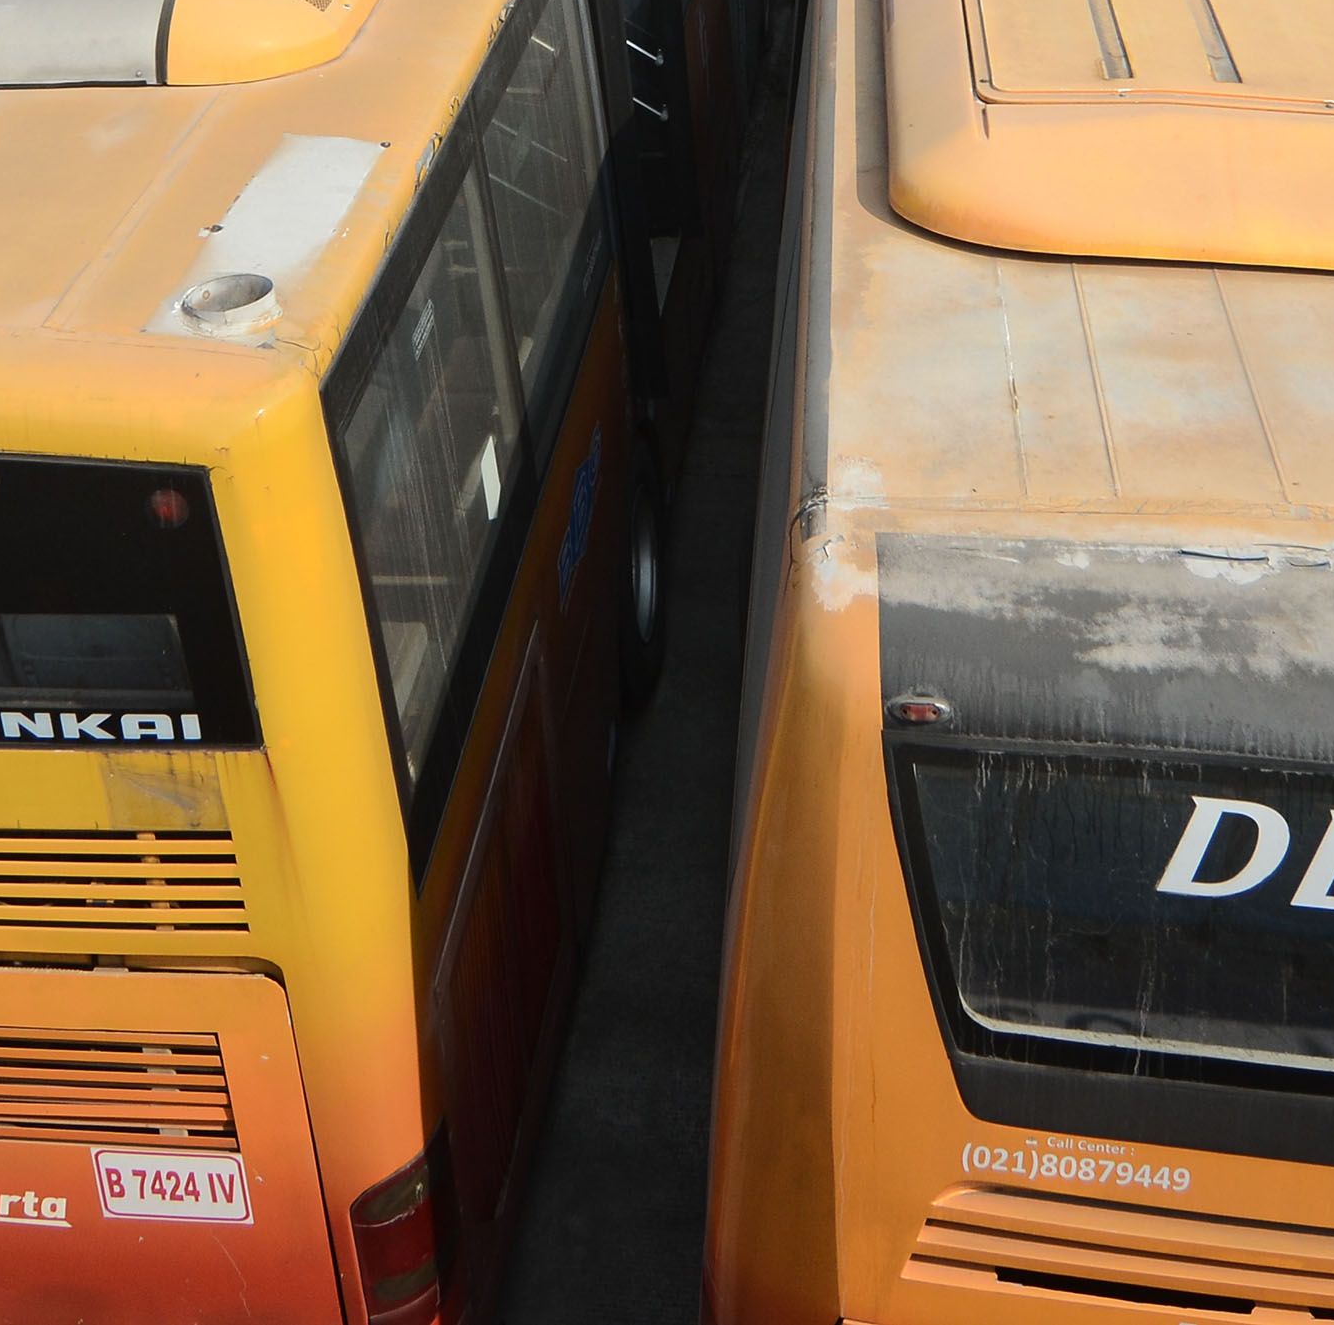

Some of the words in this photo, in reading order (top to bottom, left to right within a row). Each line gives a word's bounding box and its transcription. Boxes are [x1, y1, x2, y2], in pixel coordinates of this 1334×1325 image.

[1046, 1136, 1074, 1149] Call
[1078, 1140, 1127, 1156] Center
[961, 1141, 1191, 1192] (021)80879449
[104, 1167, 127, 1199] B
[131, 1168, 201, 1204] 7424
[207, 1171, 236, 1205] IV
